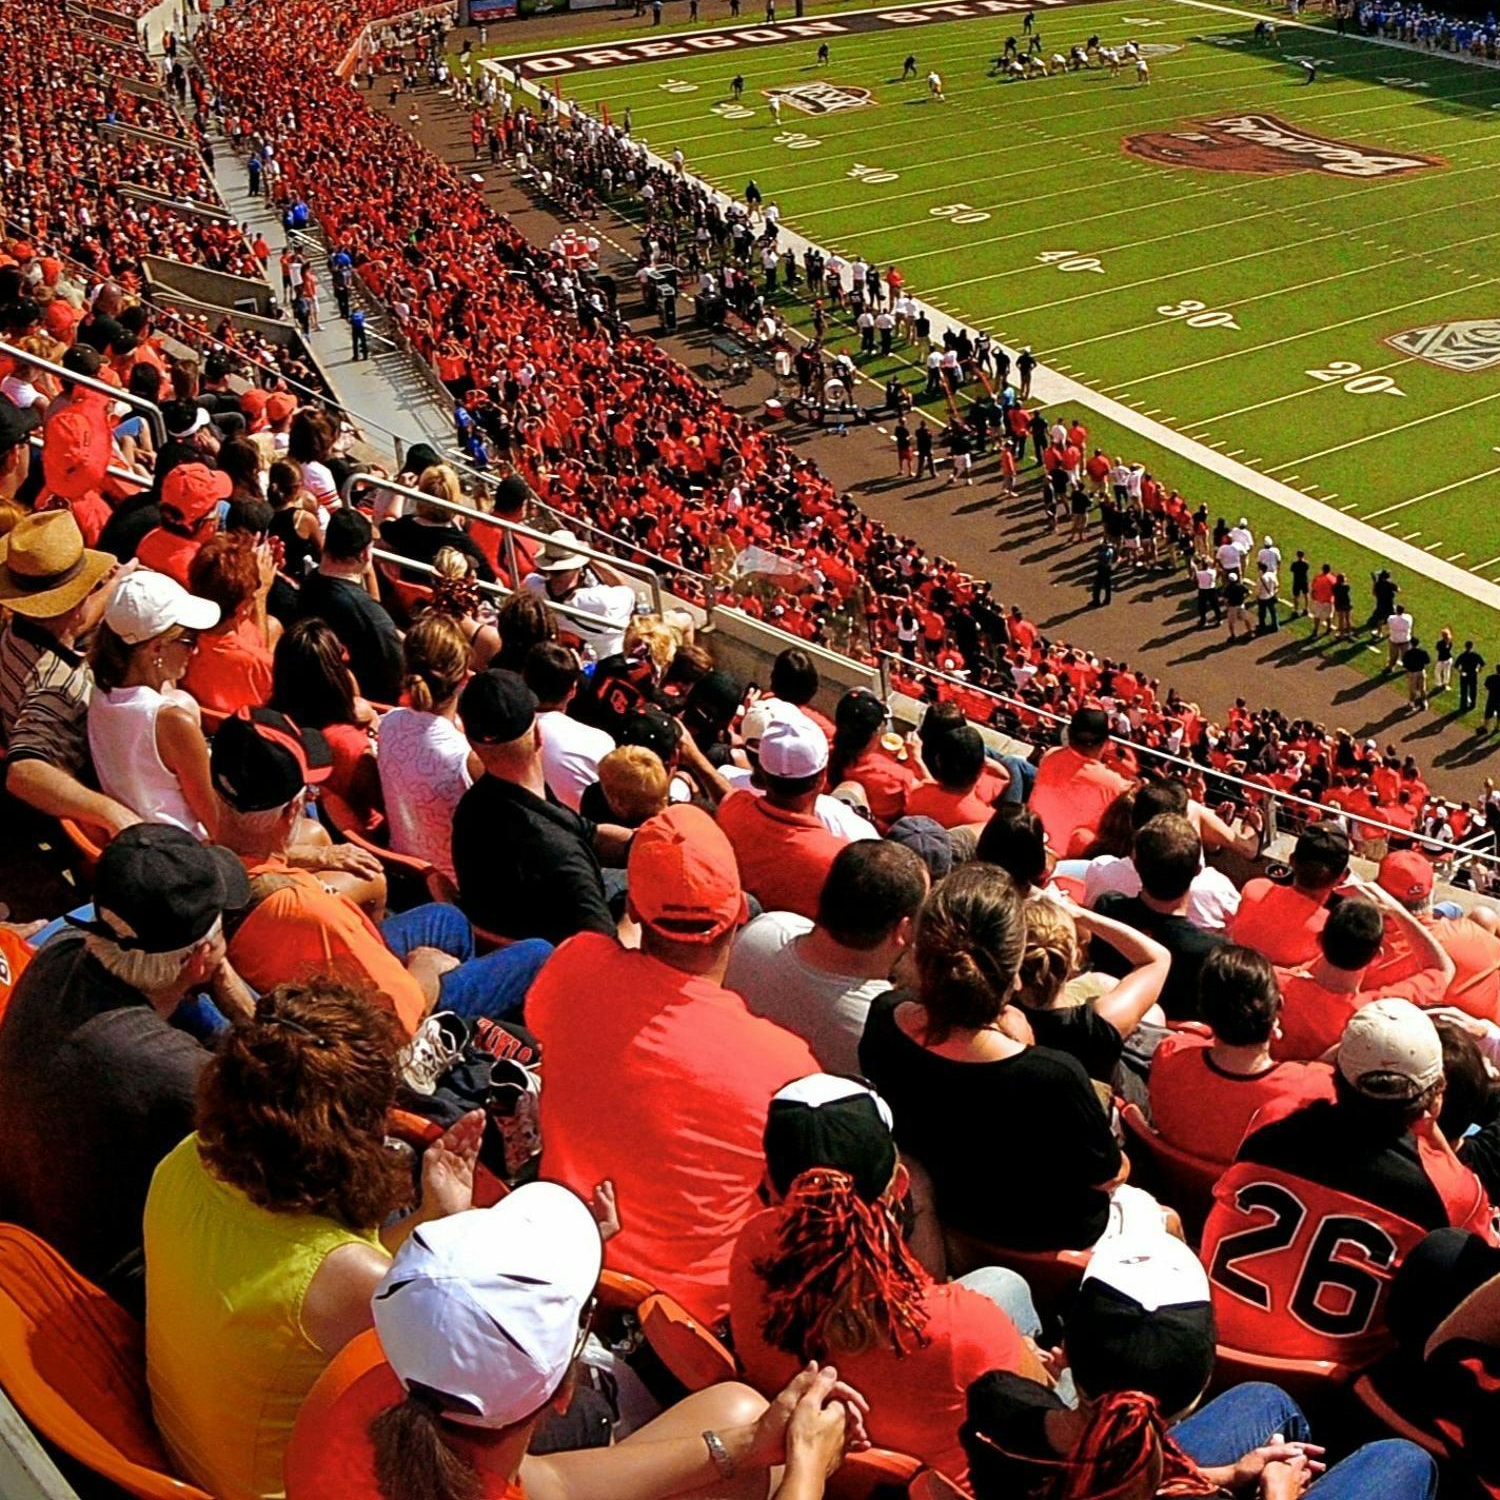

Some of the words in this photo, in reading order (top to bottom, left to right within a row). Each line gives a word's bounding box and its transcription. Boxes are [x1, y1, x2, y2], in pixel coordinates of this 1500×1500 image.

[524, 19, 849, 72] OREGON
[773, 133, 821, 150] 30
[846, 164, 899, 184] 40
[929, 204, 991, 225] 50
[1036, 250, 1100, 273] 40
[1157, 300, 1234, 329] 30
[1305, 361, 1395, 394] 20
[1208, 1181, 1398, 1338] 26
